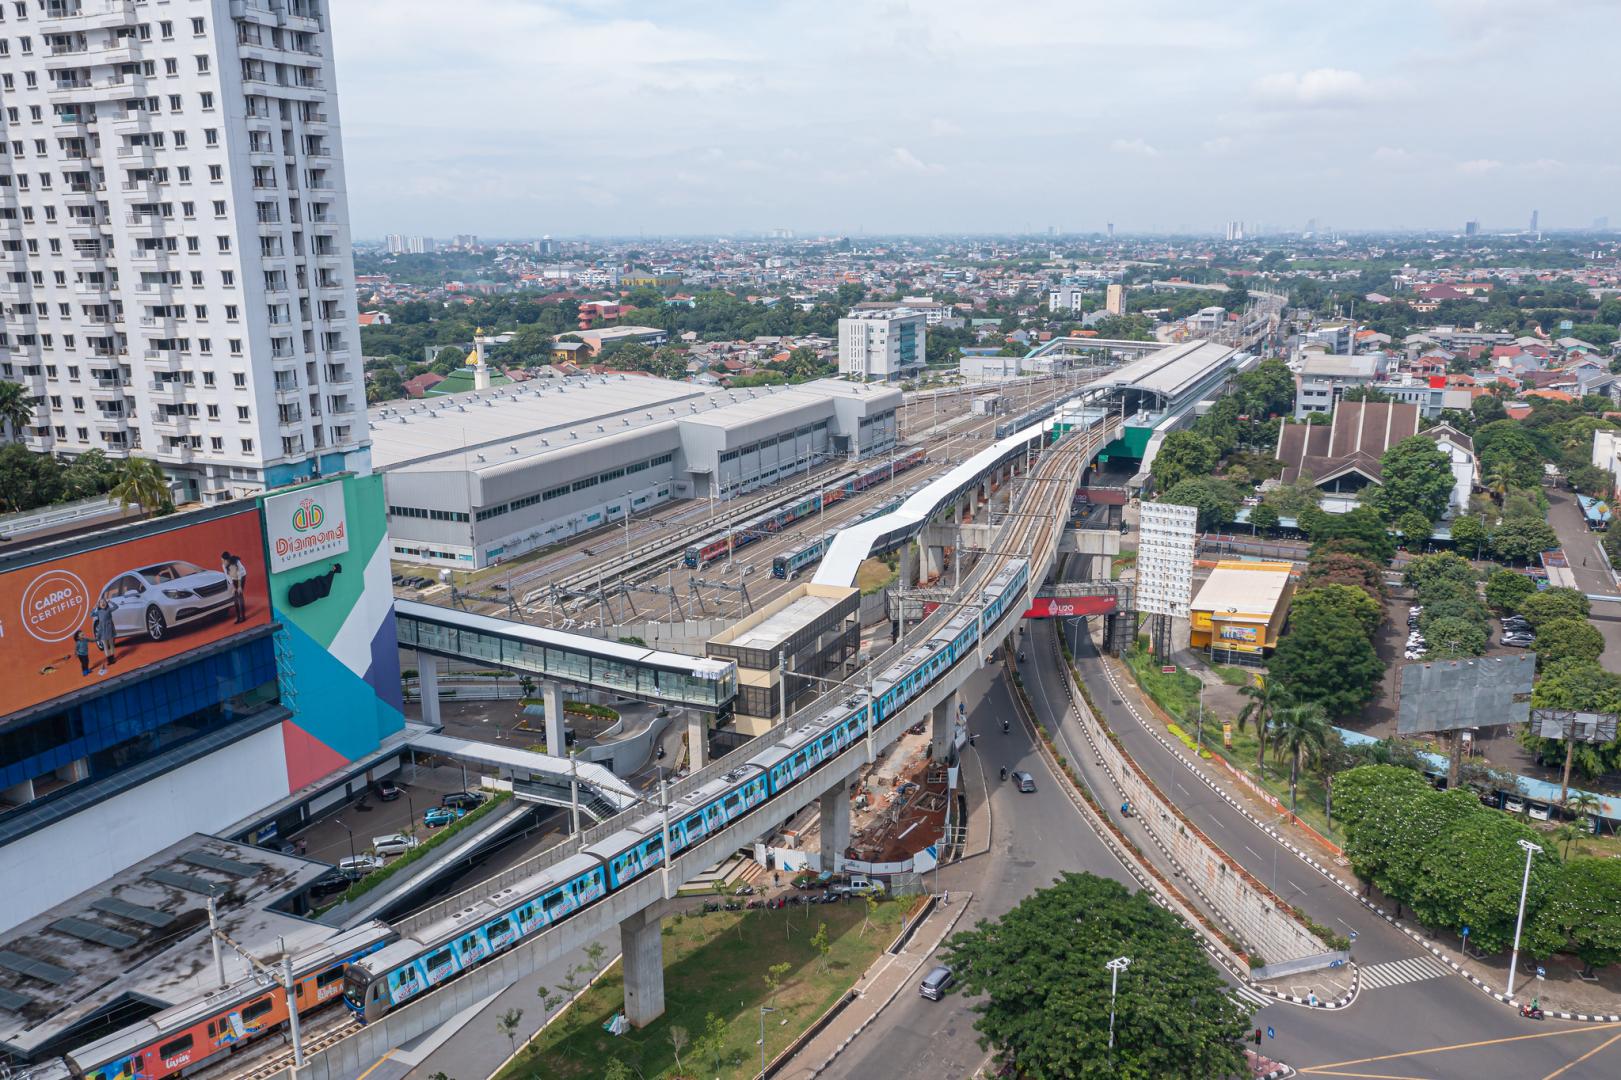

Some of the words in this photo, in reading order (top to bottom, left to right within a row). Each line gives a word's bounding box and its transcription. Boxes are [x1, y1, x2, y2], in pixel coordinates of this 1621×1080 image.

[275, 520, 345, 556] Diamond
[281, 540, 342, 562] SUPERMARKET
[31, 595, 83, 624] CERTIFIED
[35, 587, 72, 610] CARRO
